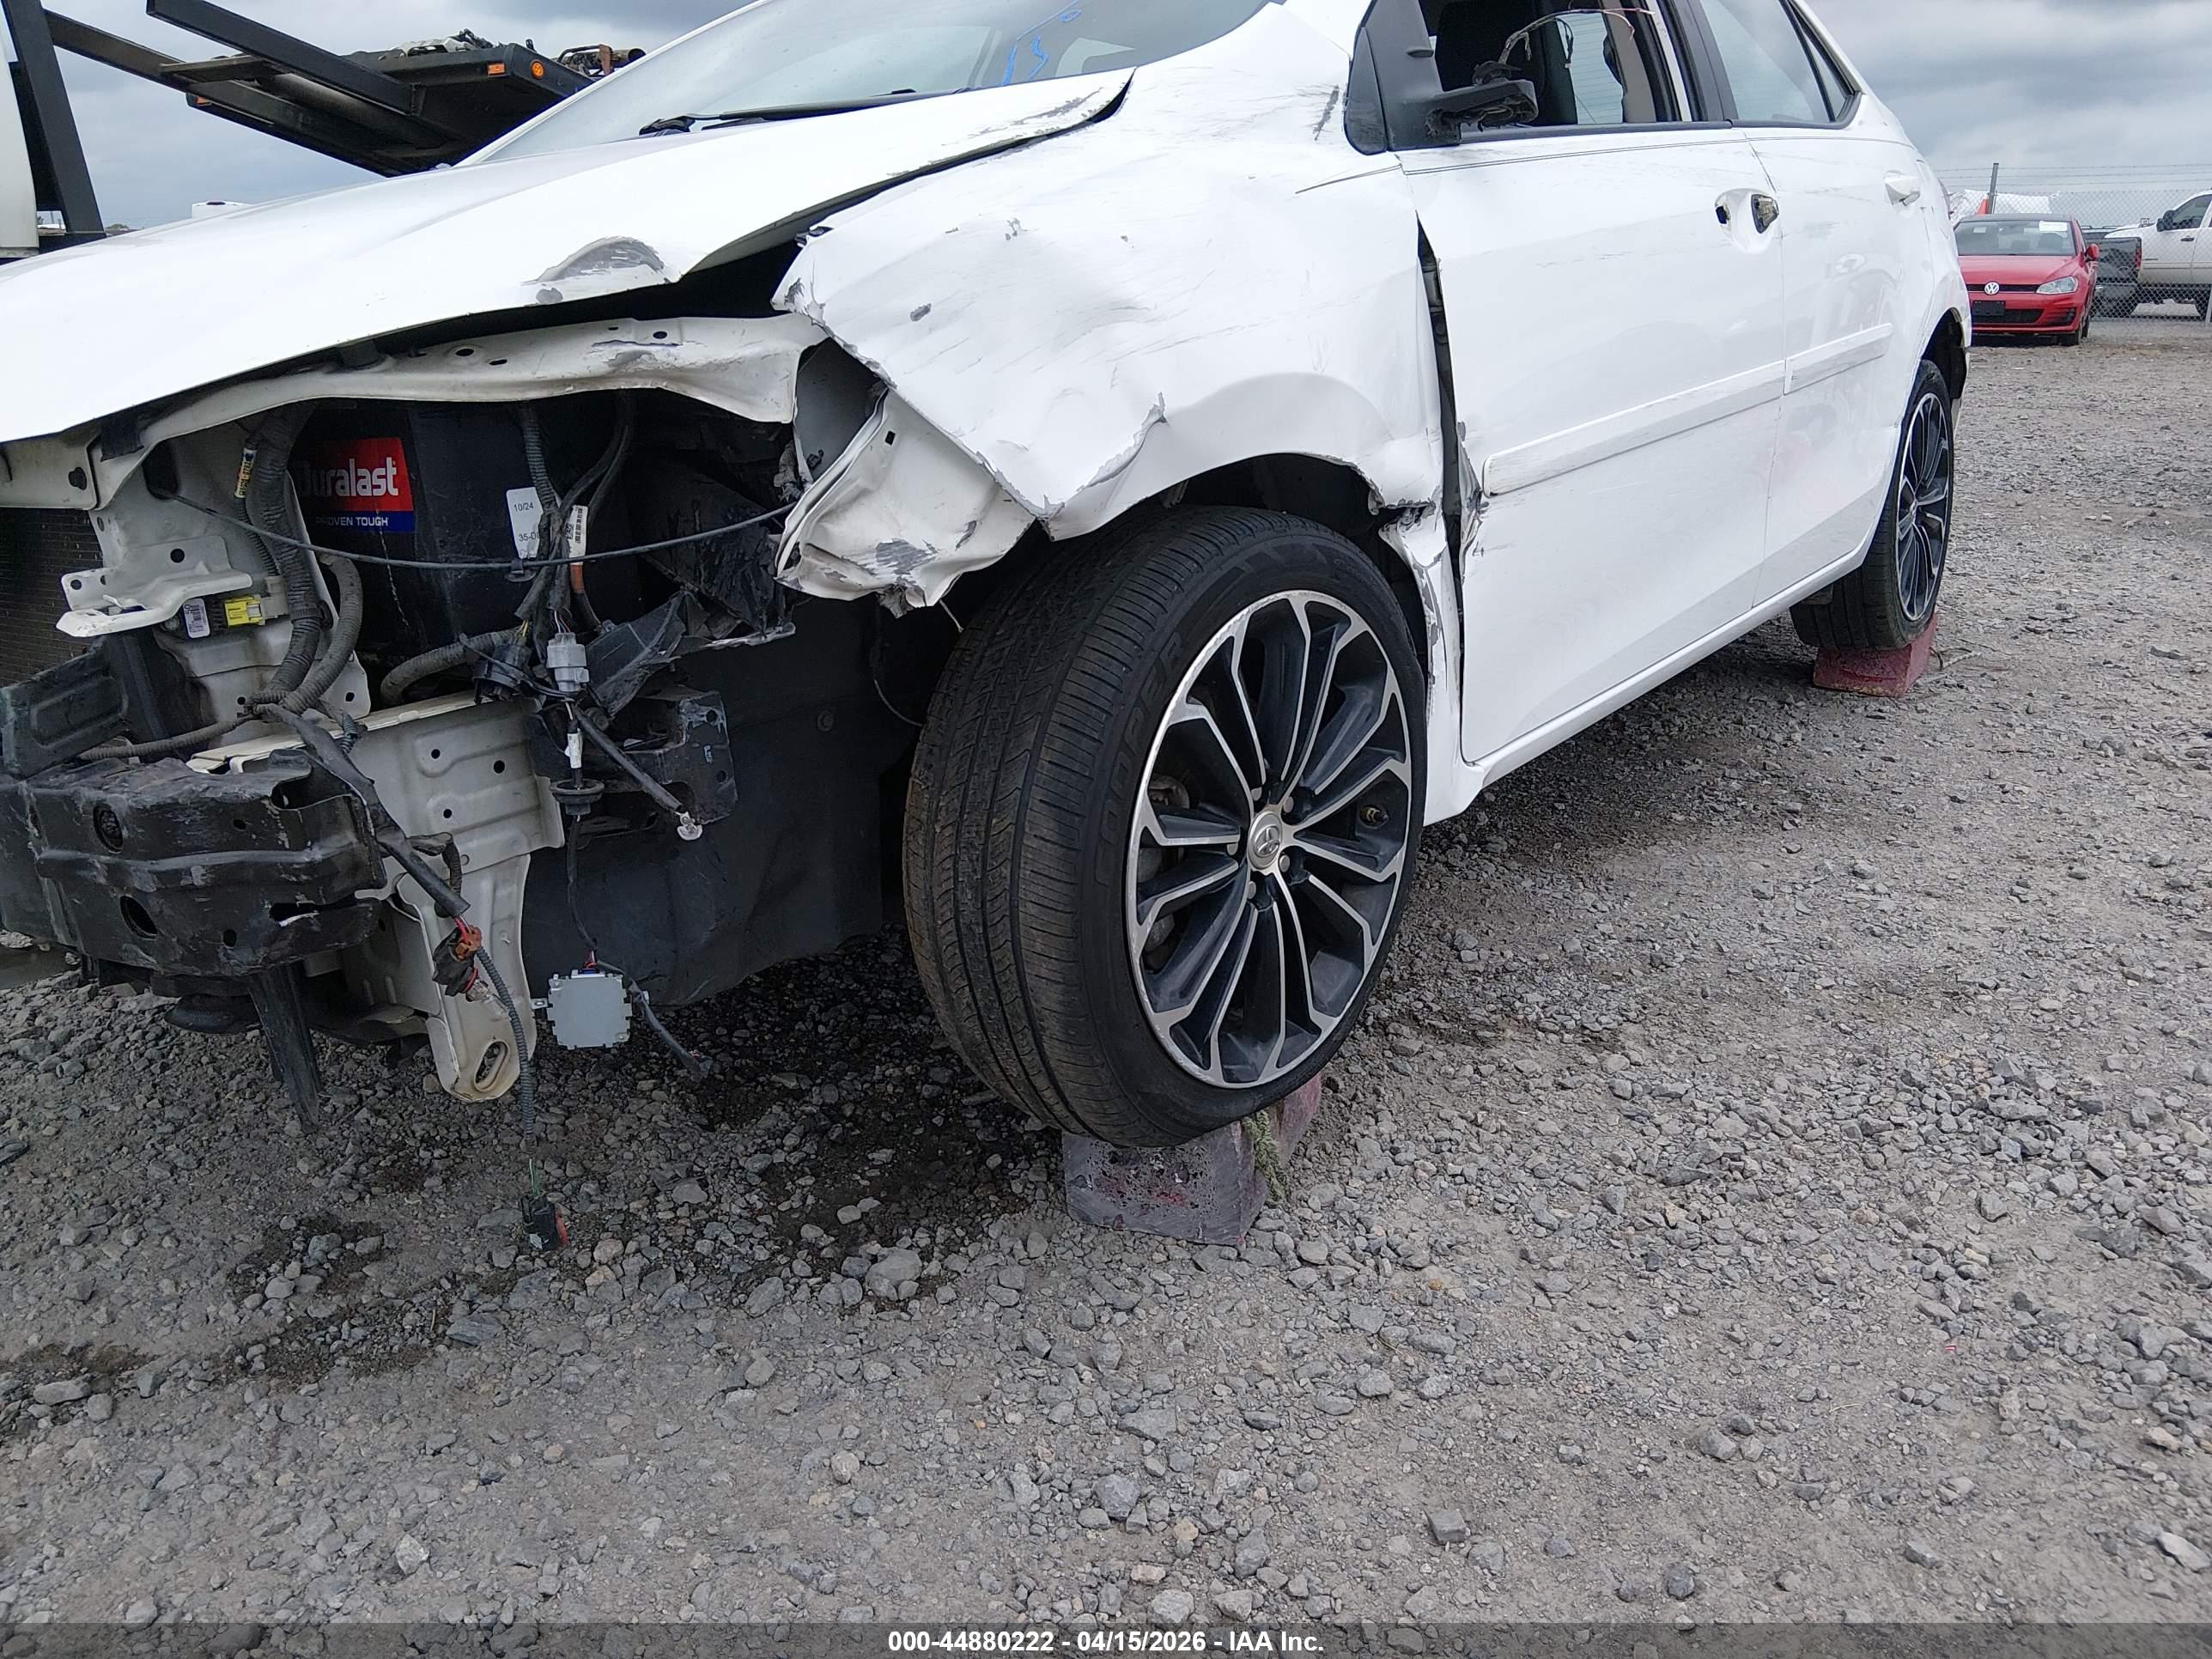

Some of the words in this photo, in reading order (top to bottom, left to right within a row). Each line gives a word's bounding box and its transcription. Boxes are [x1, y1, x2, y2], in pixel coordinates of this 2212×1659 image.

[514, 502, 534, 512] 10/24
[316, 517, 353, 526] OVEN
[356, 517, 389, 526] TOUGH
